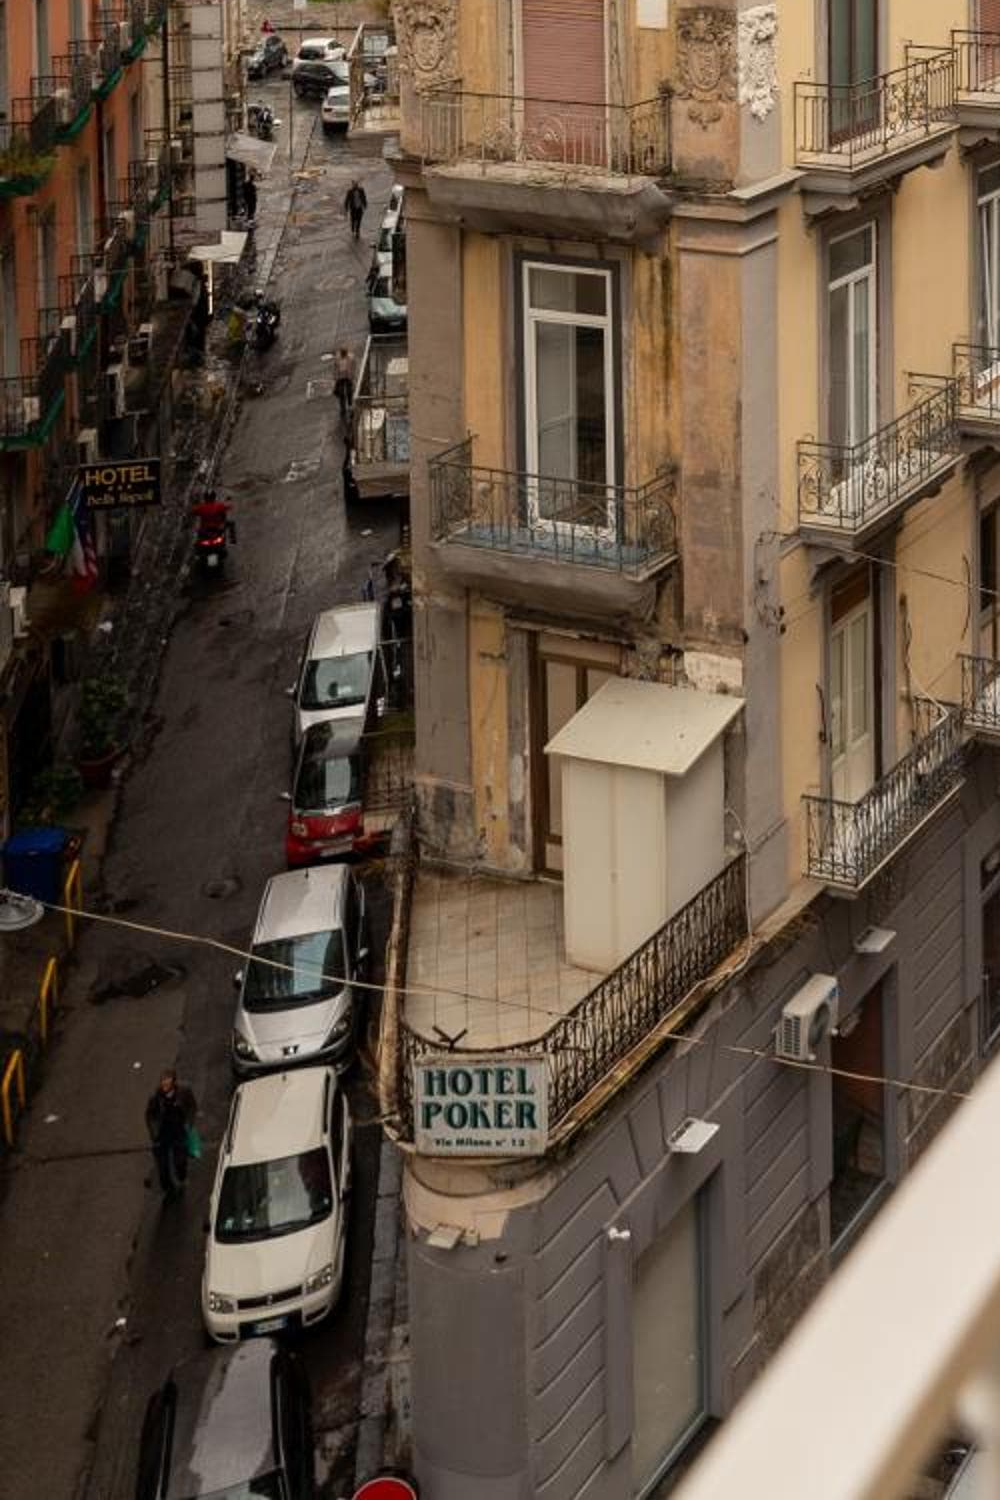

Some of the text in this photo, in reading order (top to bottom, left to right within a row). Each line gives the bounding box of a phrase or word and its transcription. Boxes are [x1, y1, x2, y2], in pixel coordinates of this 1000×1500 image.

[85, 466, 156, 486] HOTEL
[424, 1068, 535, 1096] HOTEL
[422, 1101, 536, 1129] POKER
